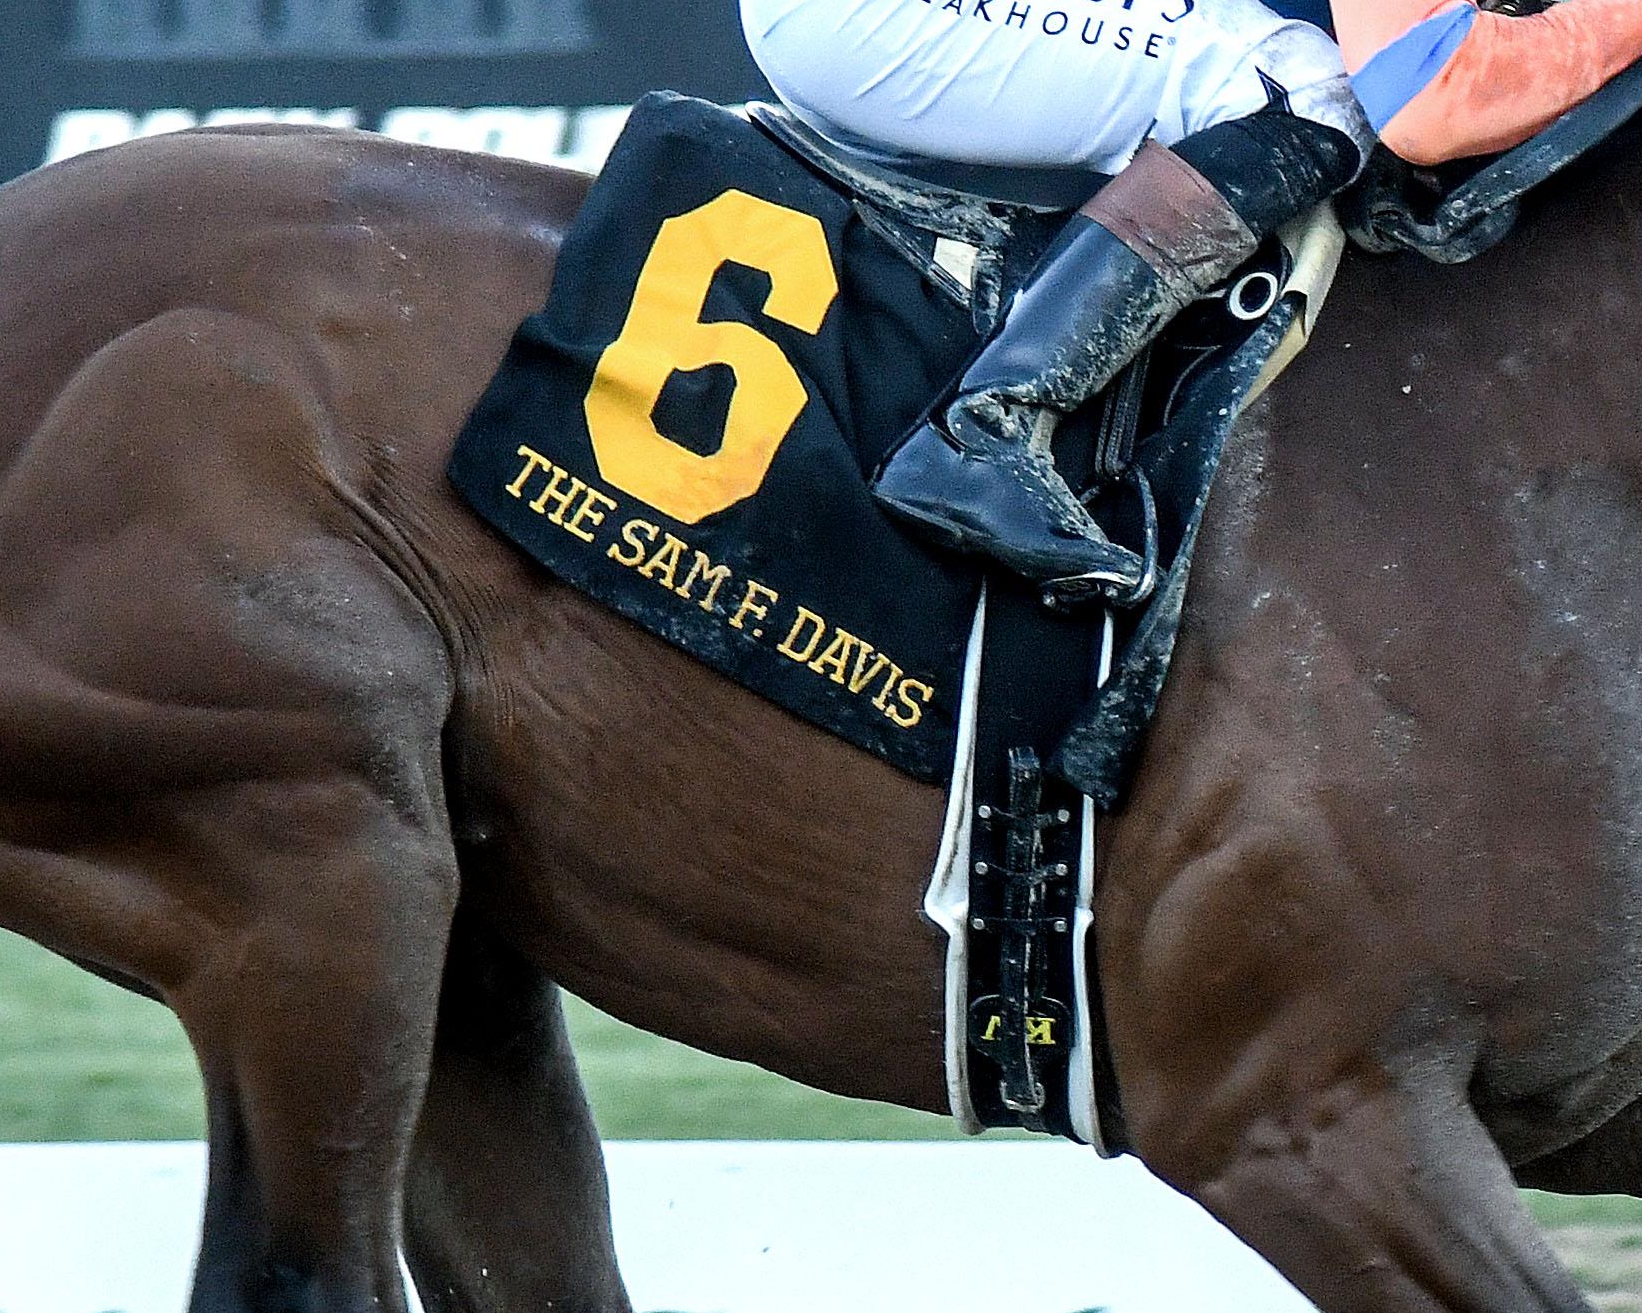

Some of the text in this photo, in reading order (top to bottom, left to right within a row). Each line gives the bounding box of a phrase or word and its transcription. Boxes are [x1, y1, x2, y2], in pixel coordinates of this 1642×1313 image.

[584, 188, 840, 525] 6
[504, 443, 619, 543] THE
[606, 517, 733, 613] SAM
[775, 605, 935, 729] DAVIS
